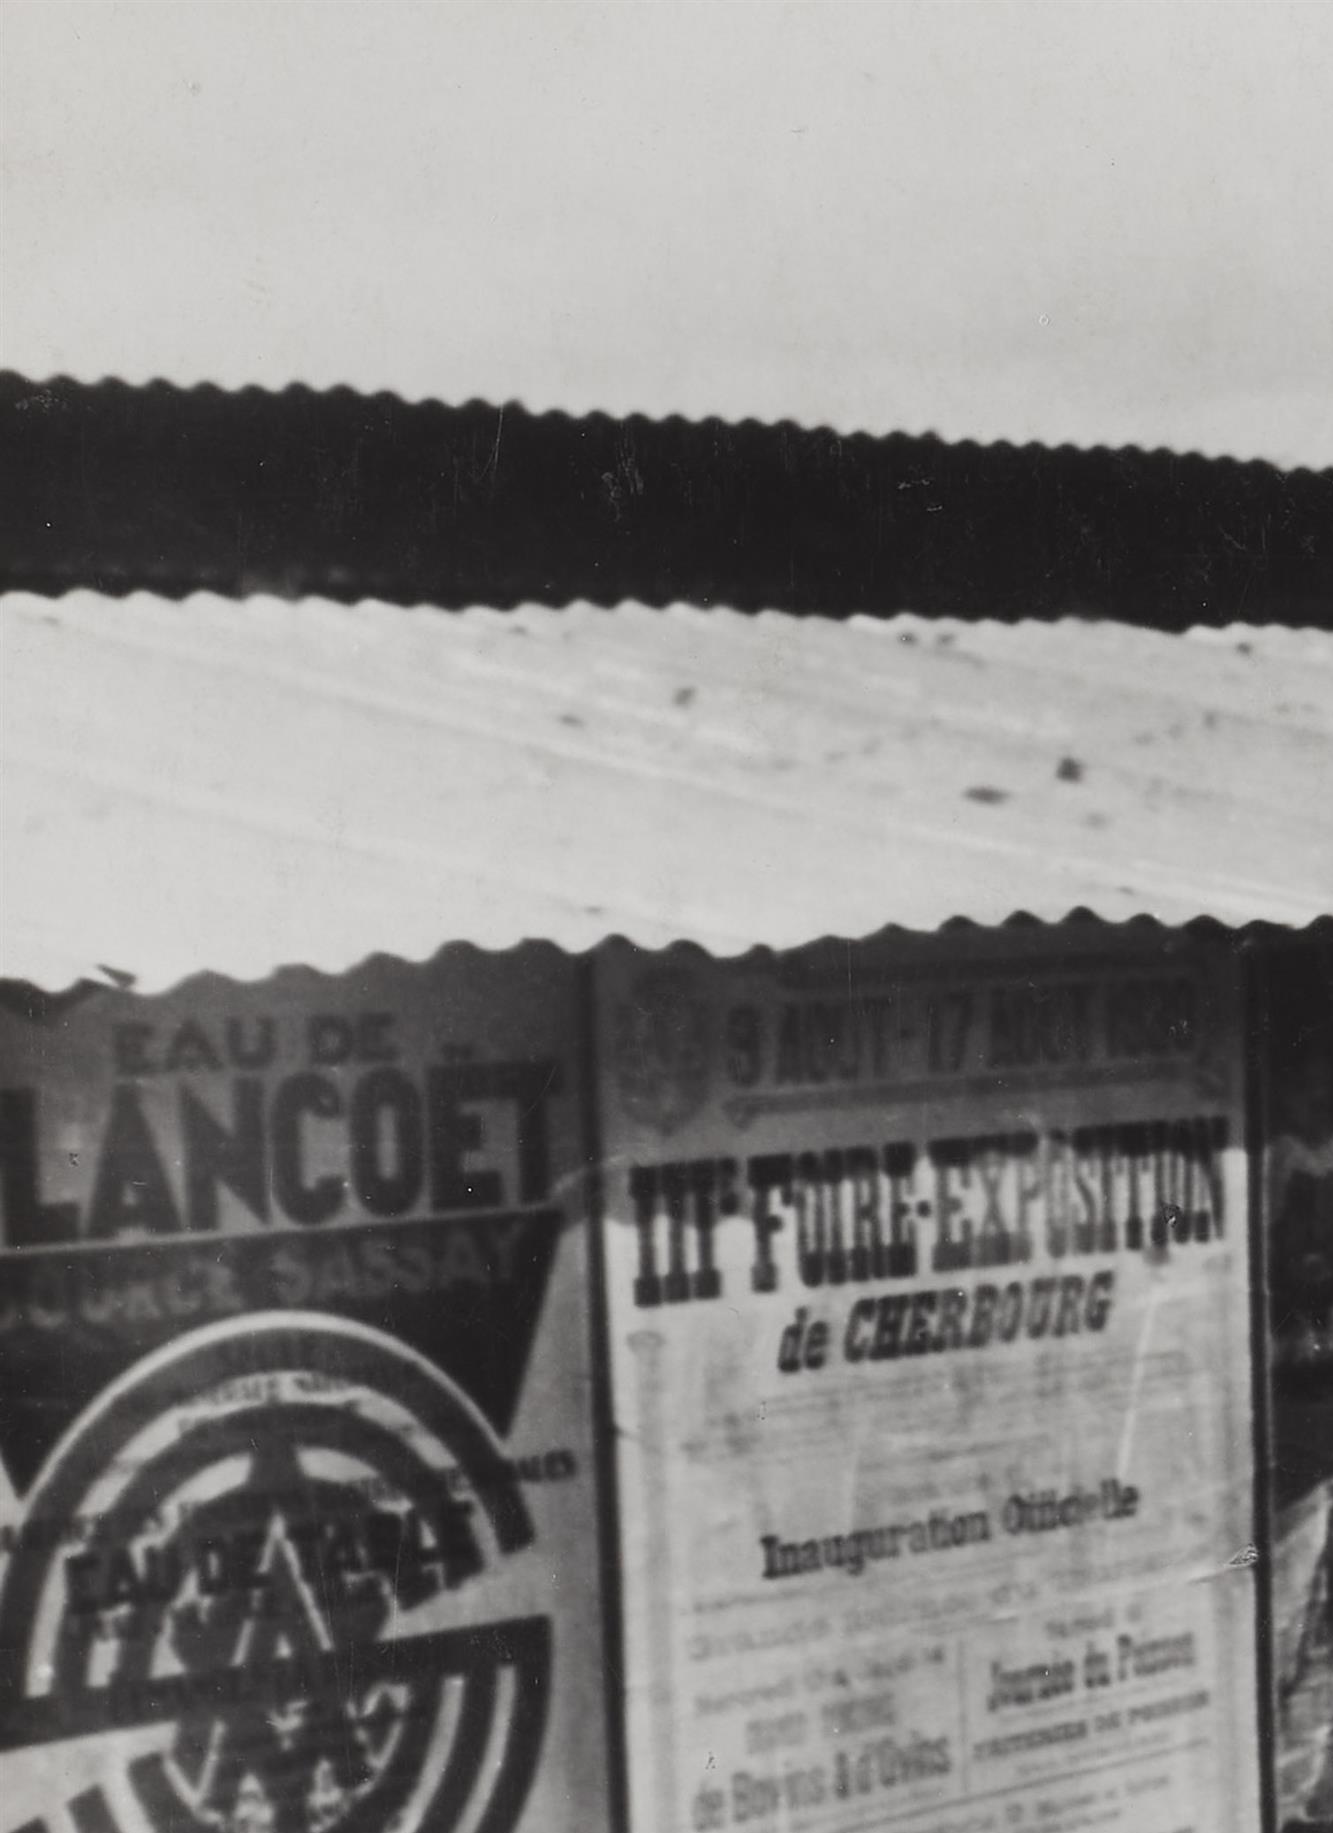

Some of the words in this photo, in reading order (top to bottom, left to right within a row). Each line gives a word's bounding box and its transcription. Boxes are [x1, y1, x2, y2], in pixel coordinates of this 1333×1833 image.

[112, 1014, 276, 1075] EAU
[308, 1009, 398, 1063] DE
[776, 1306, 828, 1375] de
[844, 1270, 1117, 1363] CHERBOURG
[758, 1506, 993, 1582] Inauguration
